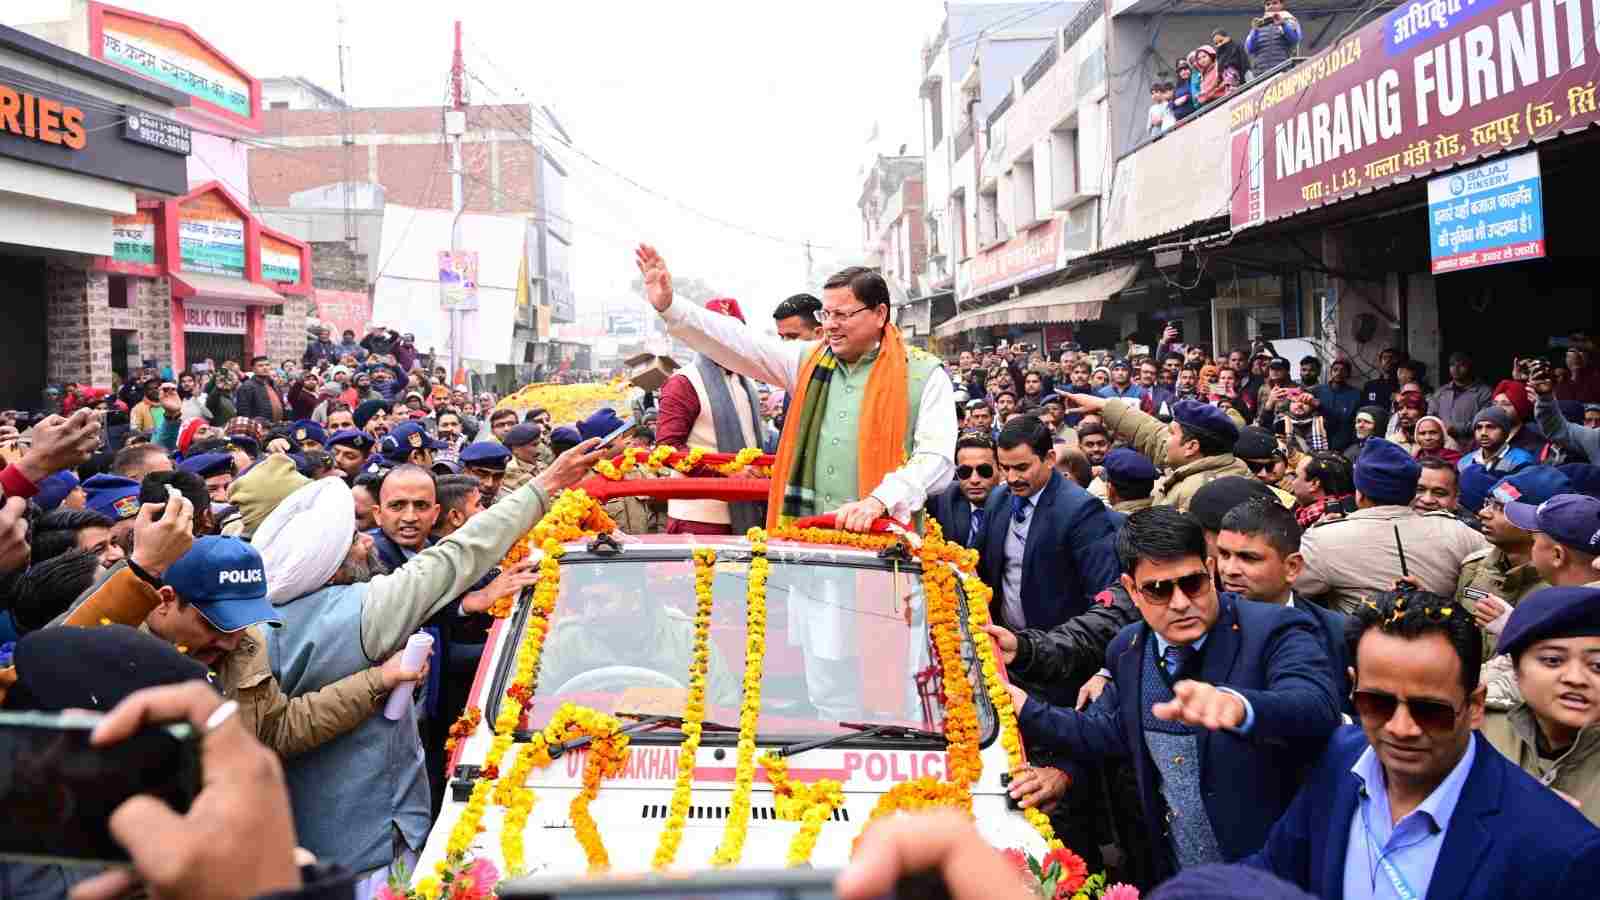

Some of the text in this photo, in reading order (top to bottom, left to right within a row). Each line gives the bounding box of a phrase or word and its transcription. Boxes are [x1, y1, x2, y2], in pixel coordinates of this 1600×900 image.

[0, 85, 88, 151] RIES
[1274, 68, 1402, 181] NARANG
[1302, 181, 1322, 201] पता
[1342, 167, 1362, 190] 13,
[1364, 153, 1401, 180] गल्ला
[1403, 140, 1431, 168] मंडी
[1435, 134, 1467, 159] रोड,
[184, 308, 246, 329] UBLIC TOILET
[219, 568, 262, 585] POLICE
